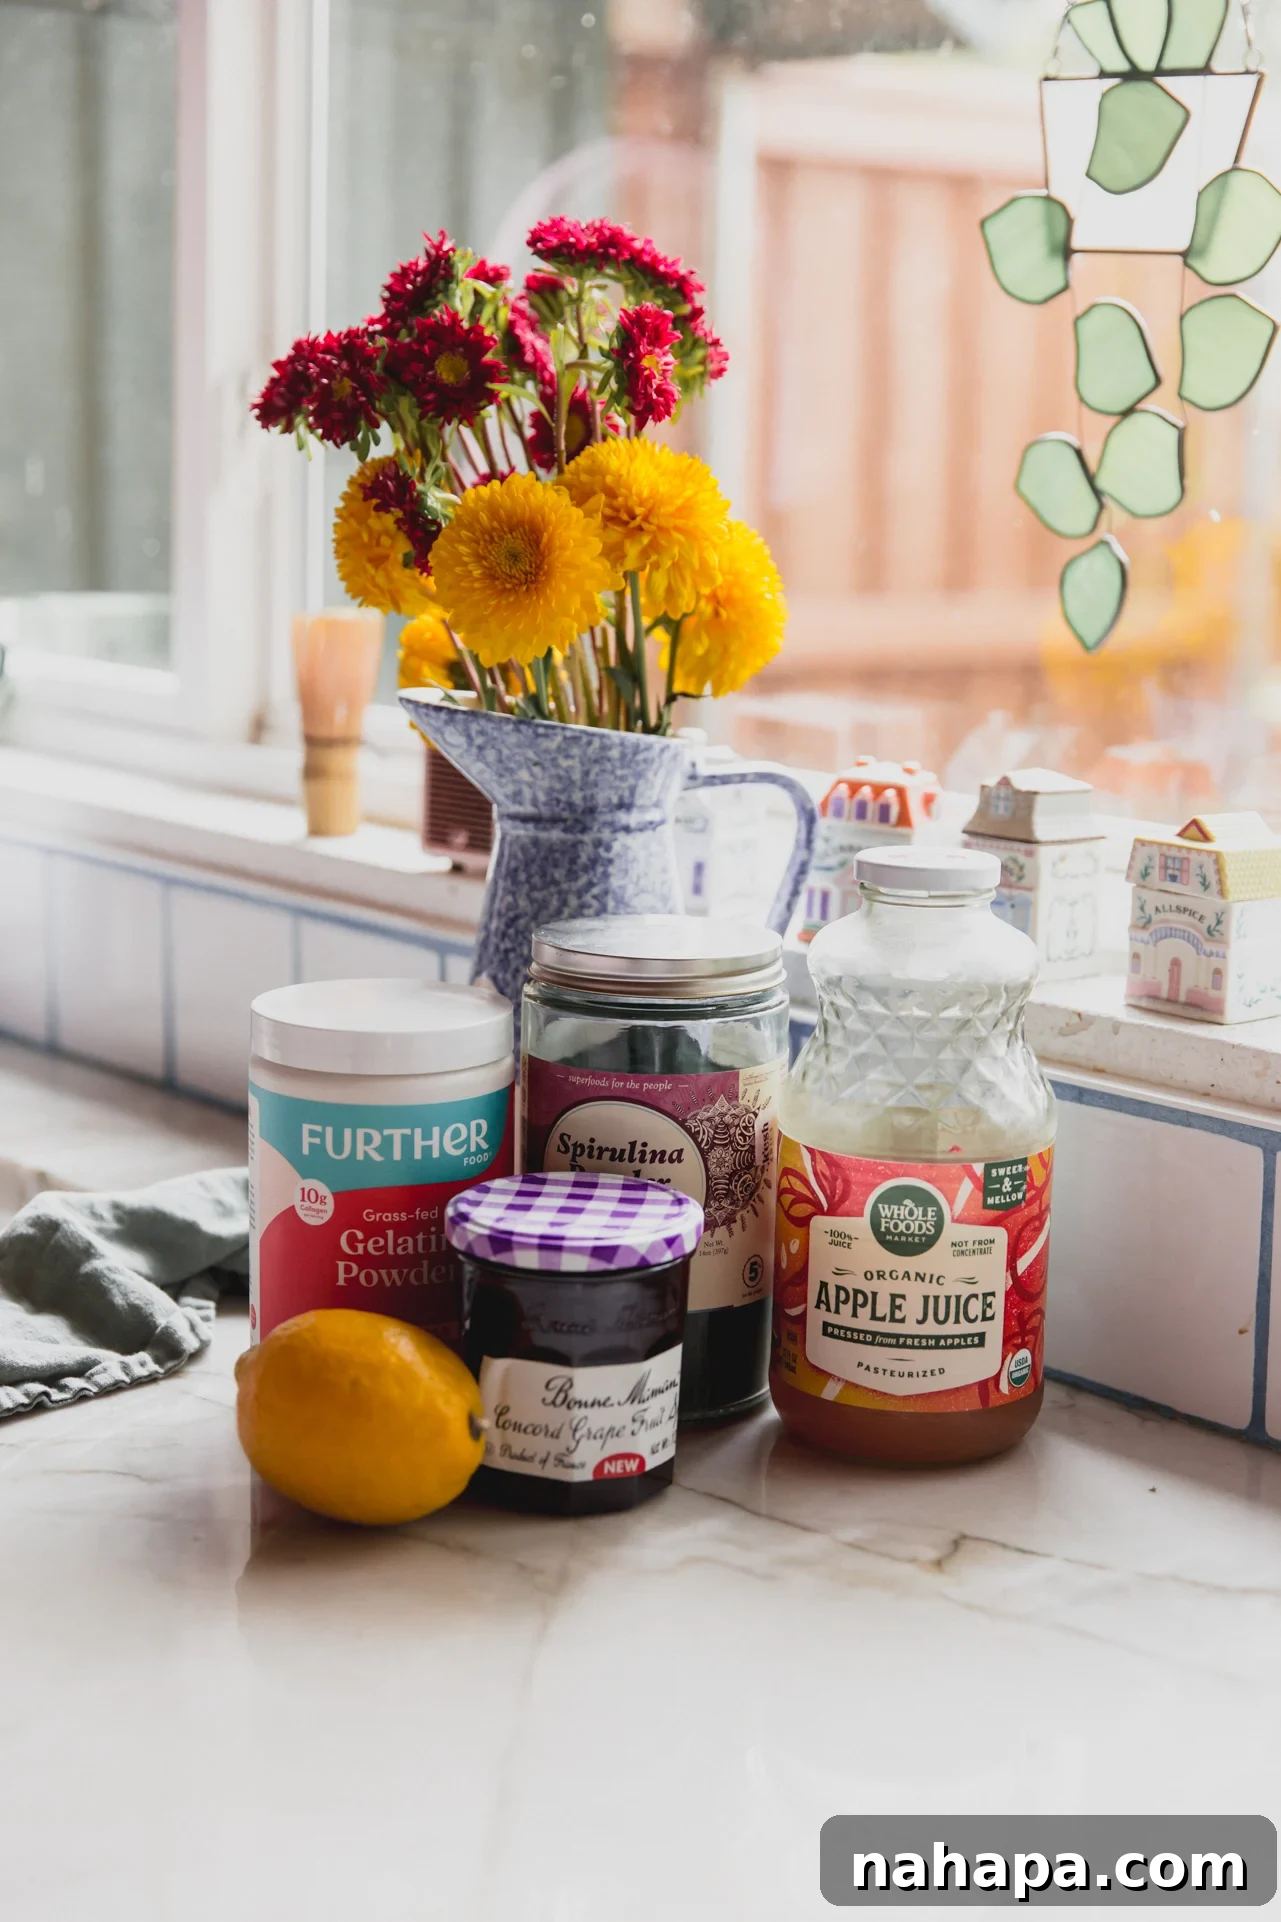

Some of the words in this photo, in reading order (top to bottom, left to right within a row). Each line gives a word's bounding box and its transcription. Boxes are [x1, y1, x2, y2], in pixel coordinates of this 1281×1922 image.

[1154, 904, 1206, 924] ALLSPICE
[568, 1075, 609, 1088] superfoods
[611, 1079, 624, 1090] for
[626, 1080, 640, 1089] the
[642, 1081, 672, 1091] people
[556, 1132, 684, 1164] Spirulina
[990, 1163, 1024, 1177] SWEET
[1001, 1177, 1012, 1193] &
[300, 1187, 327, 1206] 10g
[986, 1191, 1024, 1205] MELLOW
[300, 1204, 328, 1215] Collagen
[362, 1206, 439, 1222] Grass-fed
[877, 1201, 937, 1221] WHOLE
[880, 1219, 935, 1235] FOODS
[828, 1238, 852, 1250] JUICE
[885, 1234, 926, 1243] MARKET
[951, 1240, 969, 1248] NOT
[972, 1238, 996, 1247] FROM
[952, 1247, 993, 1258] CONCENTRATE
[863, 1269, 946, 1286] ORGANIC
[814, 1280, 907, 1324] APPLE
[916, 1291, 996, 1325] JUICE
[827, 1326, 873, 1342] PRESSED
[874, 1334, 897, 1345] from
[899, 1337, 936, 1347] FRESH
[939, 1336, 979, 1347] APPLES
[857, 1361, 946, 1378] PASTEURIZED
[1014, 1355, 1028, 1368] USDA
[541, 1375, 614, 1410] Bonne
[494, 1403, 565, 1440] Concord
[566, 1415, 626, 1453] Grape
[631, 1406, 666, 1438] Fruit
[499, 1442, 537, 1463] Product
[538, 1453, 549, 1470] of
[553, 1452, 588, 1470] France
[603, 1458, 640, 1474] NEW
